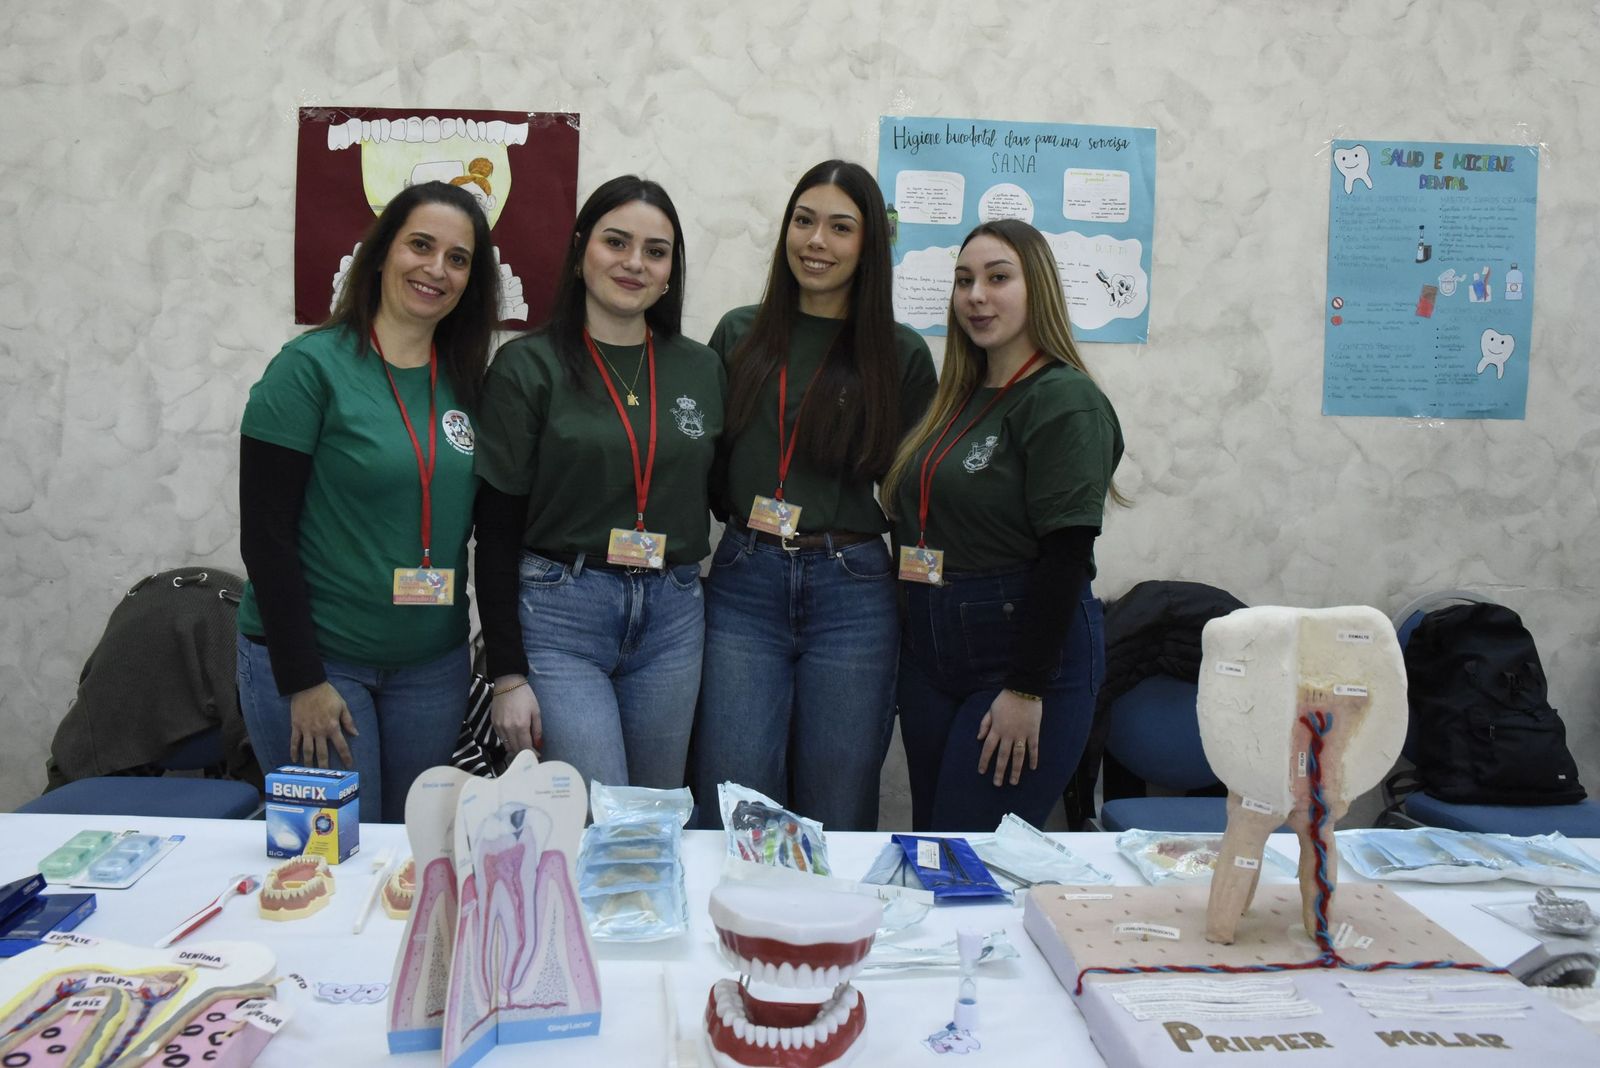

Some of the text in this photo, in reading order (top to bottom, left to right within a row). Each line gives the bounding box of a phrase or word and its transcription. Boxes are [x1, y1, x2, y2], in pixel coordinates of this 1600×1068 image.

[894, 125, 941, 155] Higiene
[1004, 129, 1030, 149] clave
[1034, 134, 1059, 153] para
[1060, 136, 1080, 148] una
[1088, 136, 1130, 152] sonrisa
[991, 151, 1036, 174] SANA
[1381, 147, 1516, 172] SALUD E HIGIENE
[1418, 174, 1469, 191] DENTAL
[272, 782, 327, 800] BENFIX
[49, 934, 91, 945] ESMALTE
[179, 951, 221, 962] DENTINA
[94, 975, 133, 987] PULPA
[72, 997, 101, 1007] RAÍZ
[1162, 1020, 1514, 1053] PRIMER MOLAR
